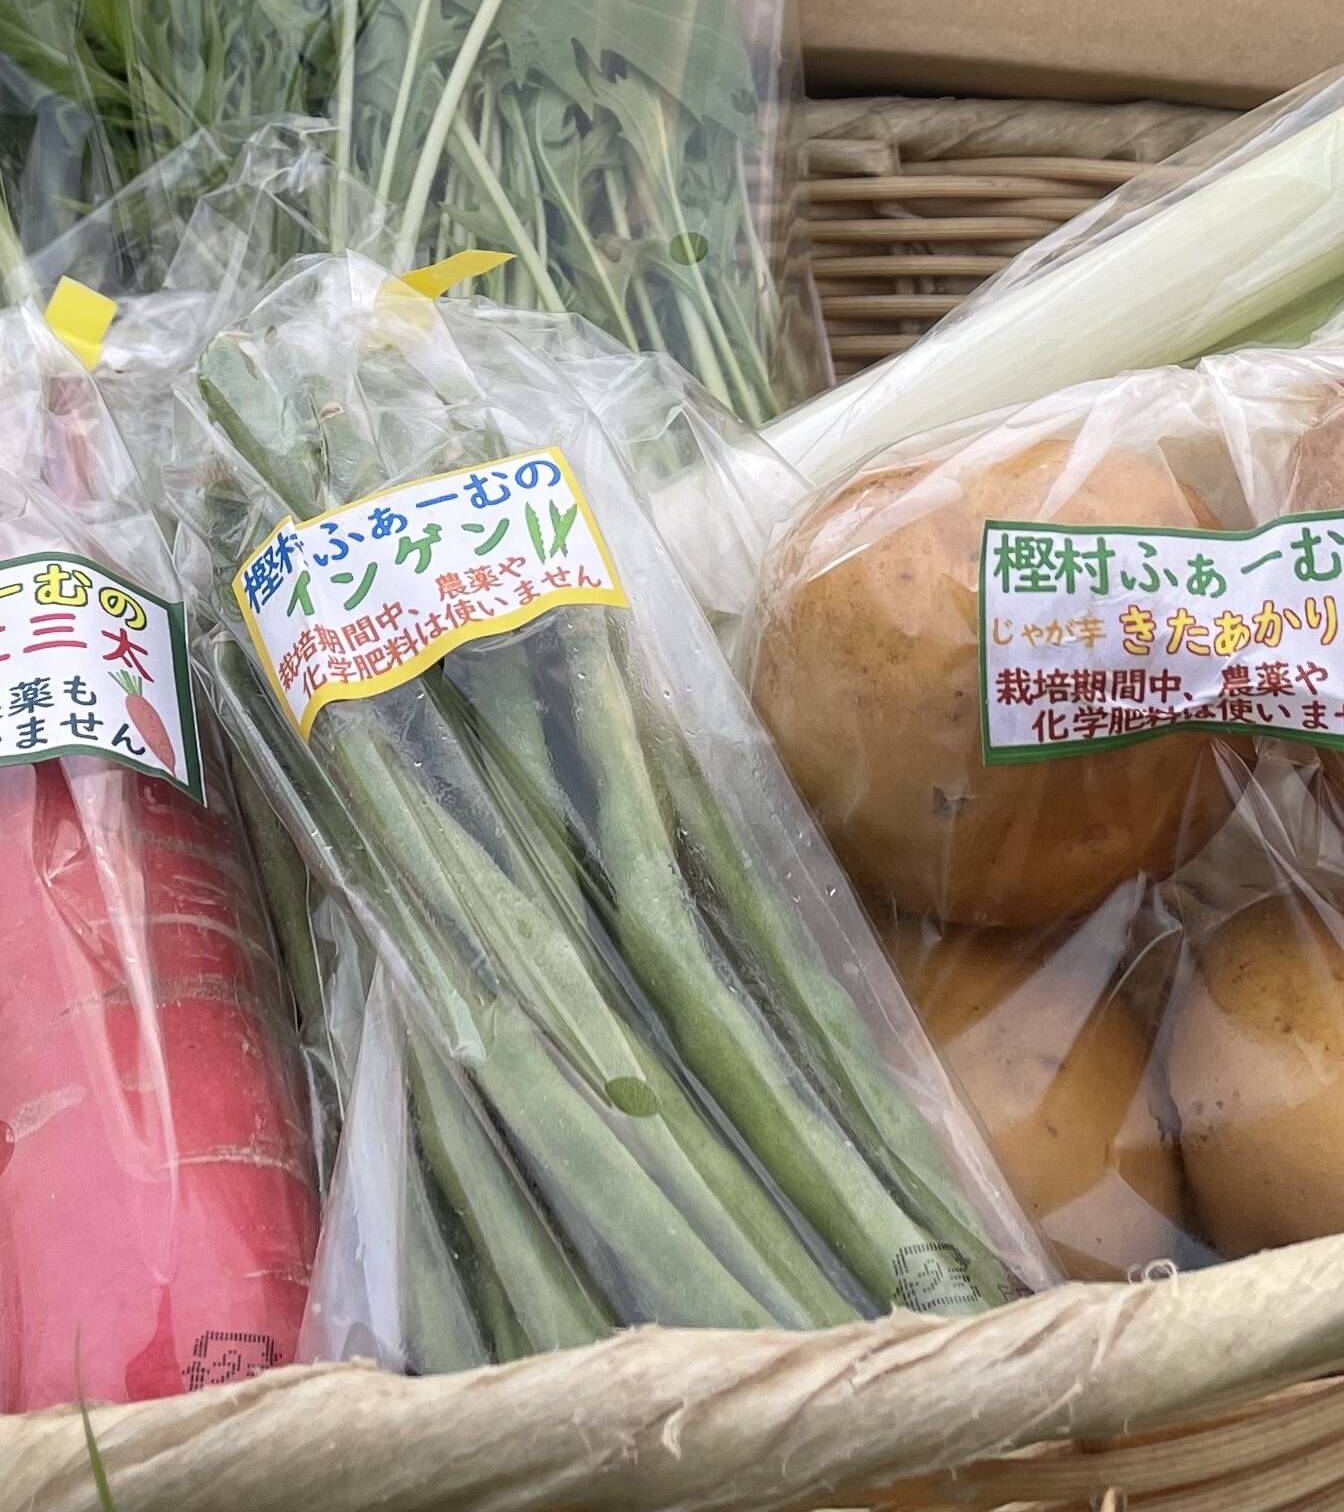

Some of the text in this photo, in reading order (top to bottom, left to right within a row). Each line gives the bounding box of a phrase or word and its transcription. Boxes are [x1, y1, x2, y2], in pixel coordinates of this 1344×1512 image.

[286, 517, 510, 618] インゲン
[302, 564, 602, 700] 化学肥料は使いません
[992, 595, 1338, 656] じゃが芋 きたあかり
